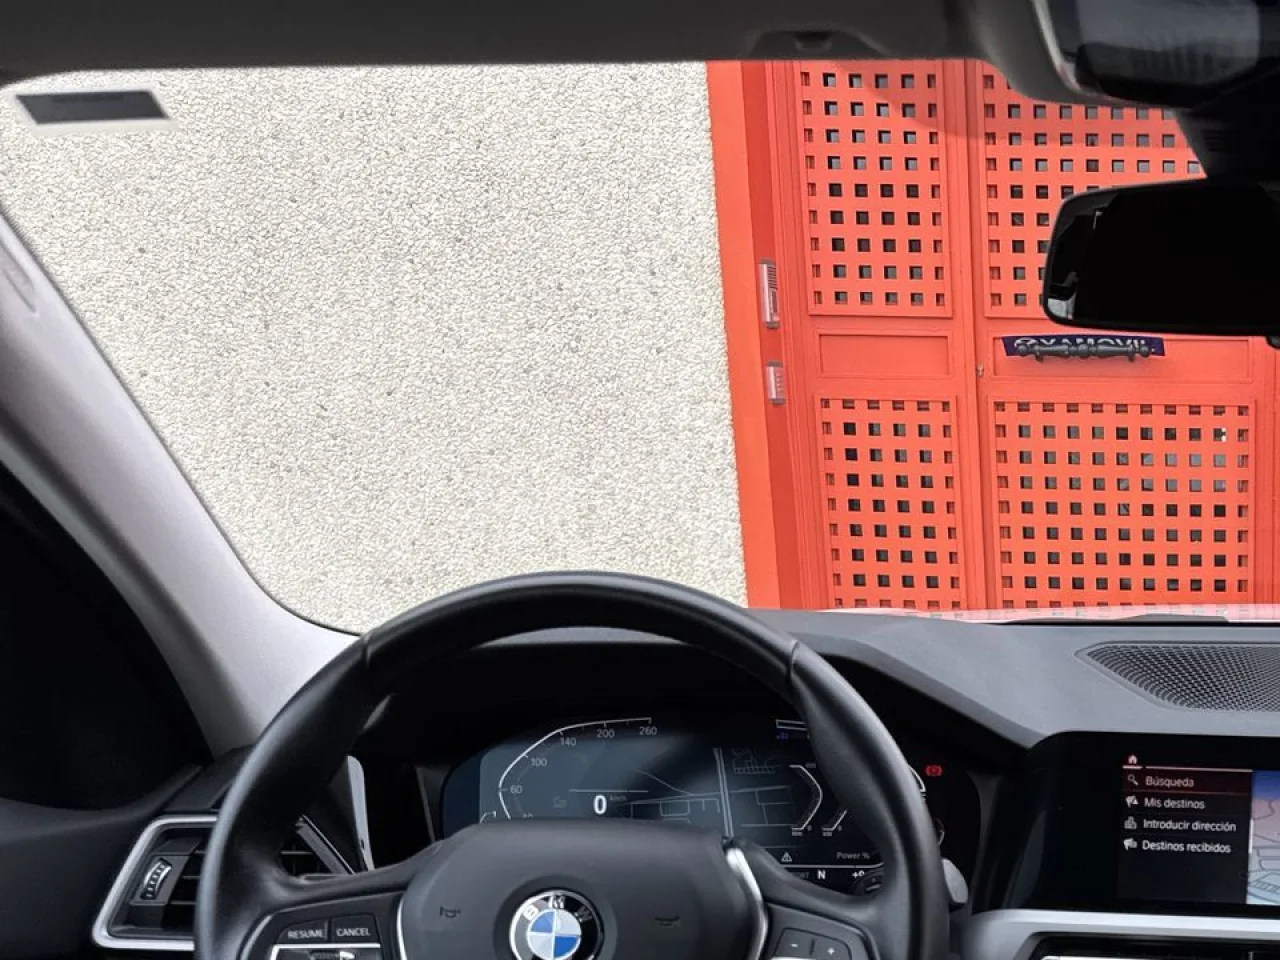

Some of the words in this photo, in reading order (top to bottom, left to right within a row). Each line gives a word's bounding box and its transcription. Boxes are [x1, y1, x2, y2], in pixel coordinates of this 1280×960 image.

[596, 728, 615, 739] 200
[639, 726, 658, 736] 260
[560, 737, 577, 747] 140
[531, 757, 548, 767] 100
[1145, 775, 1194, 788] Búsqueda
[510, 785, 523, 794] 60
[593, 794, 607, 815] 0
[1144, 797, 1162, 808] Mis
[1164, 798, 1205, 809] destinos
[1143, 818, 1190, 831] Introducir
[1191, 821, 1237, 832] dirección
[1142, 839, 1184, 851] Destinos
[1186, 841, 1231, 853] recibidos
[817, 870, 826, 879] N
[522, 895, 593, 923] BMW
[287, 930, 324, 939] RESUME
[336, 928, 371, 937] CANCEL
